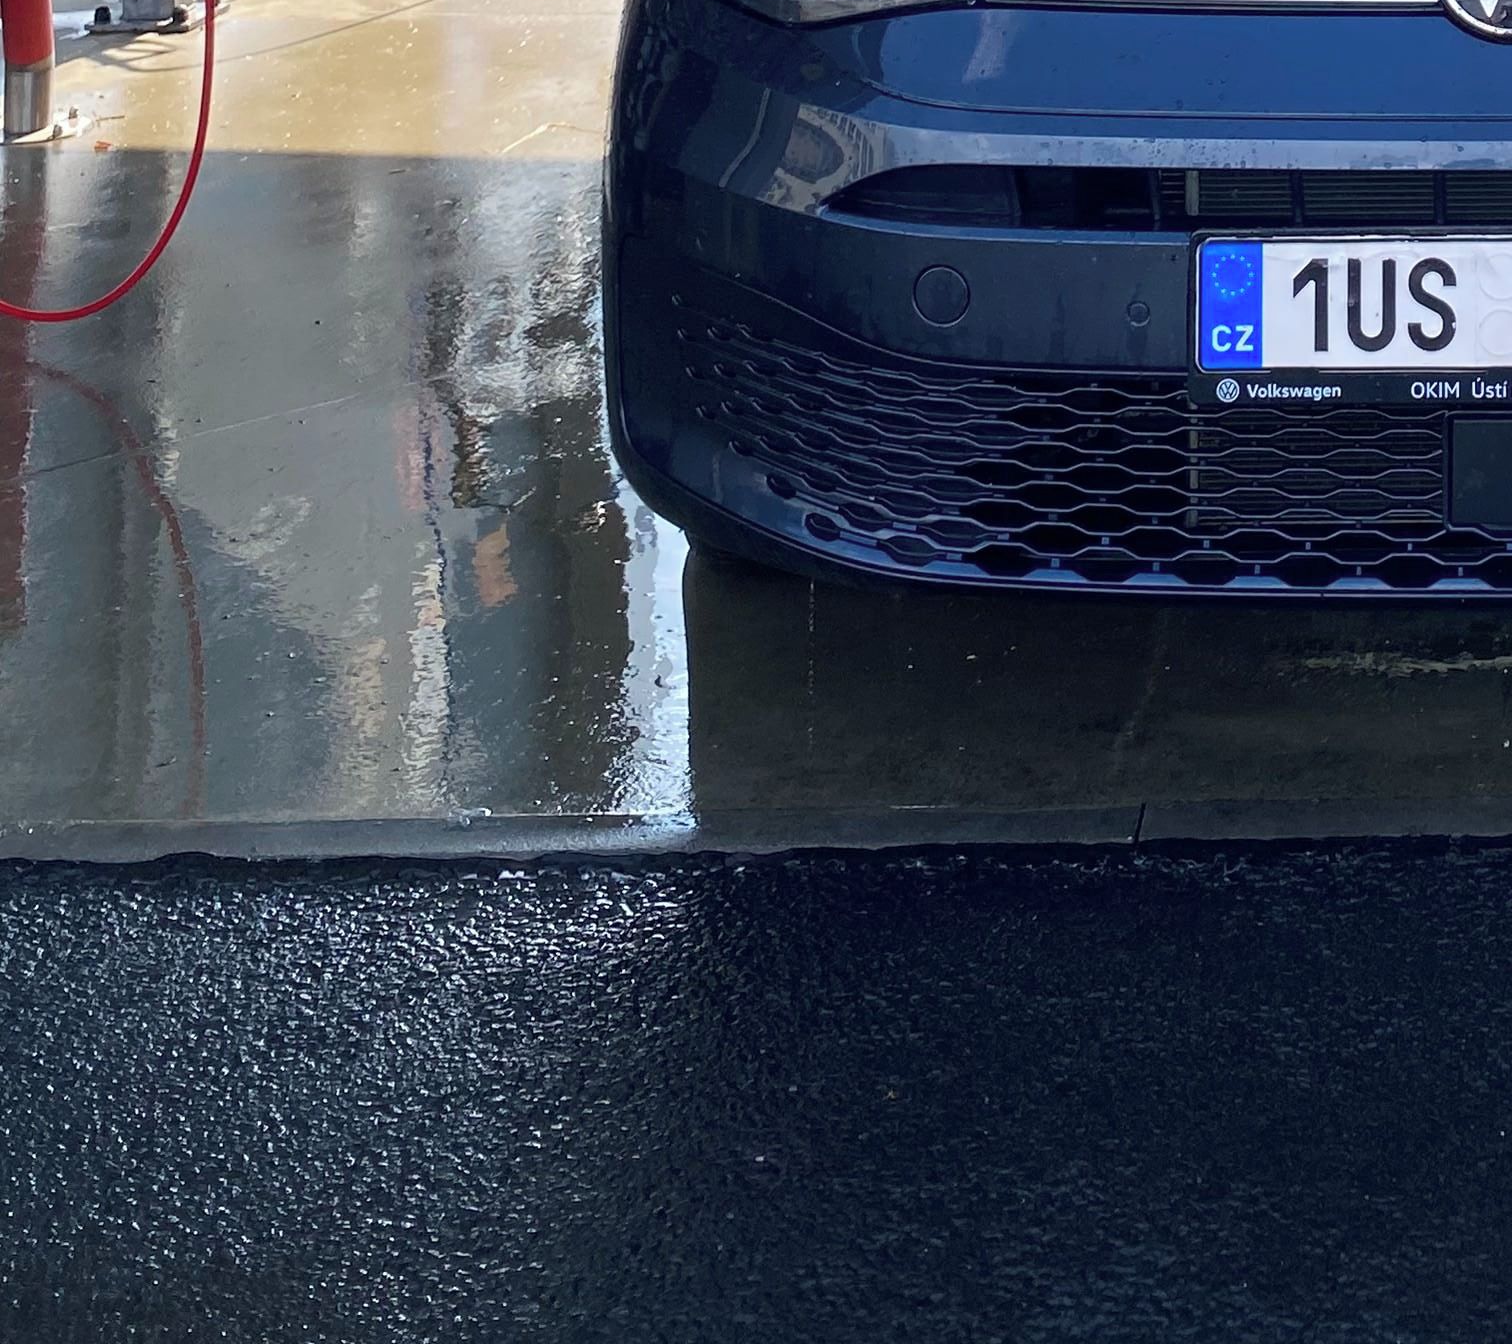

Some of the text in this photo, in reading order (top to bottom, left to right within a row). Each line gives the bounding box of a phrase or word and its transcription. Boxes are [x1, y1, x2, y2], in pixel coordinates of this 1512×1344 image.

[1293, 257, 1457, 352] 1US
[1211, 324, 1254, 353] CZ
[1246, 382, 1342, 402] Volkswagen
[1410, 381, 1460, 399] OKIM
[1471, 377, 1508, 399] Ústí
